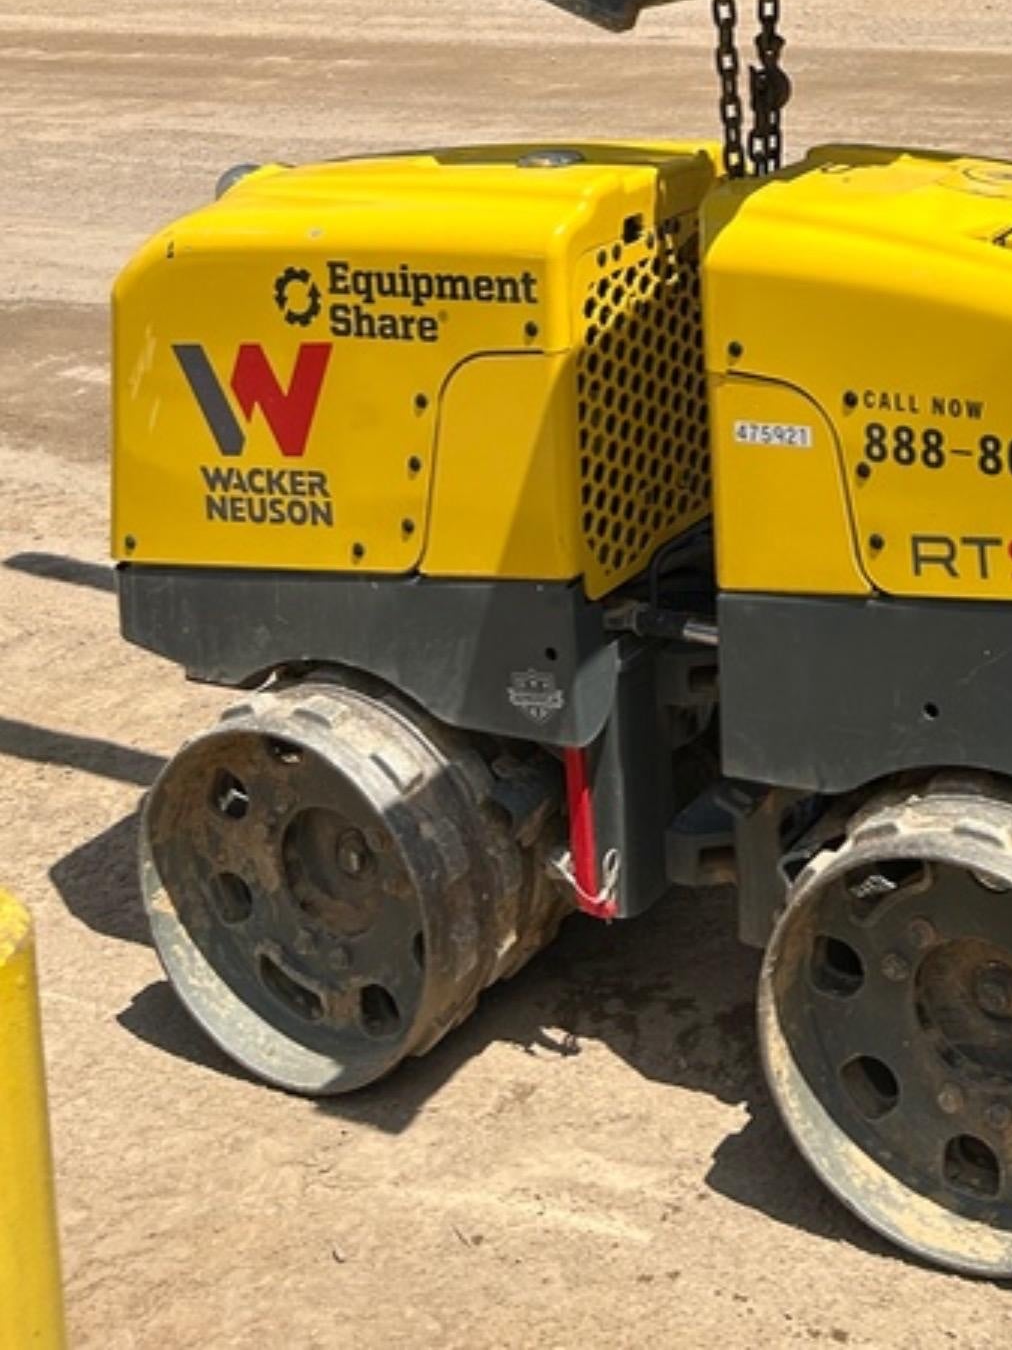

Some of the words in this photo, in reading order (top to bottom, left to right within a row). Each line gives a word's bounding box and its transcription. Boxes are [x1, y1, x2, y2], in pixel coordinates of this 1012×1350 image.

[326, 261, 539, 306] Equipment
[330, 303, 440, 342] Share
[863, 389, 921, 414] CALL
[932, 397, 984, 420] NOW
[736, 424, 809, 446] 475921
[201, 466, 330, 498] WACKER
[206, 495, 334, 528] NEUSON
